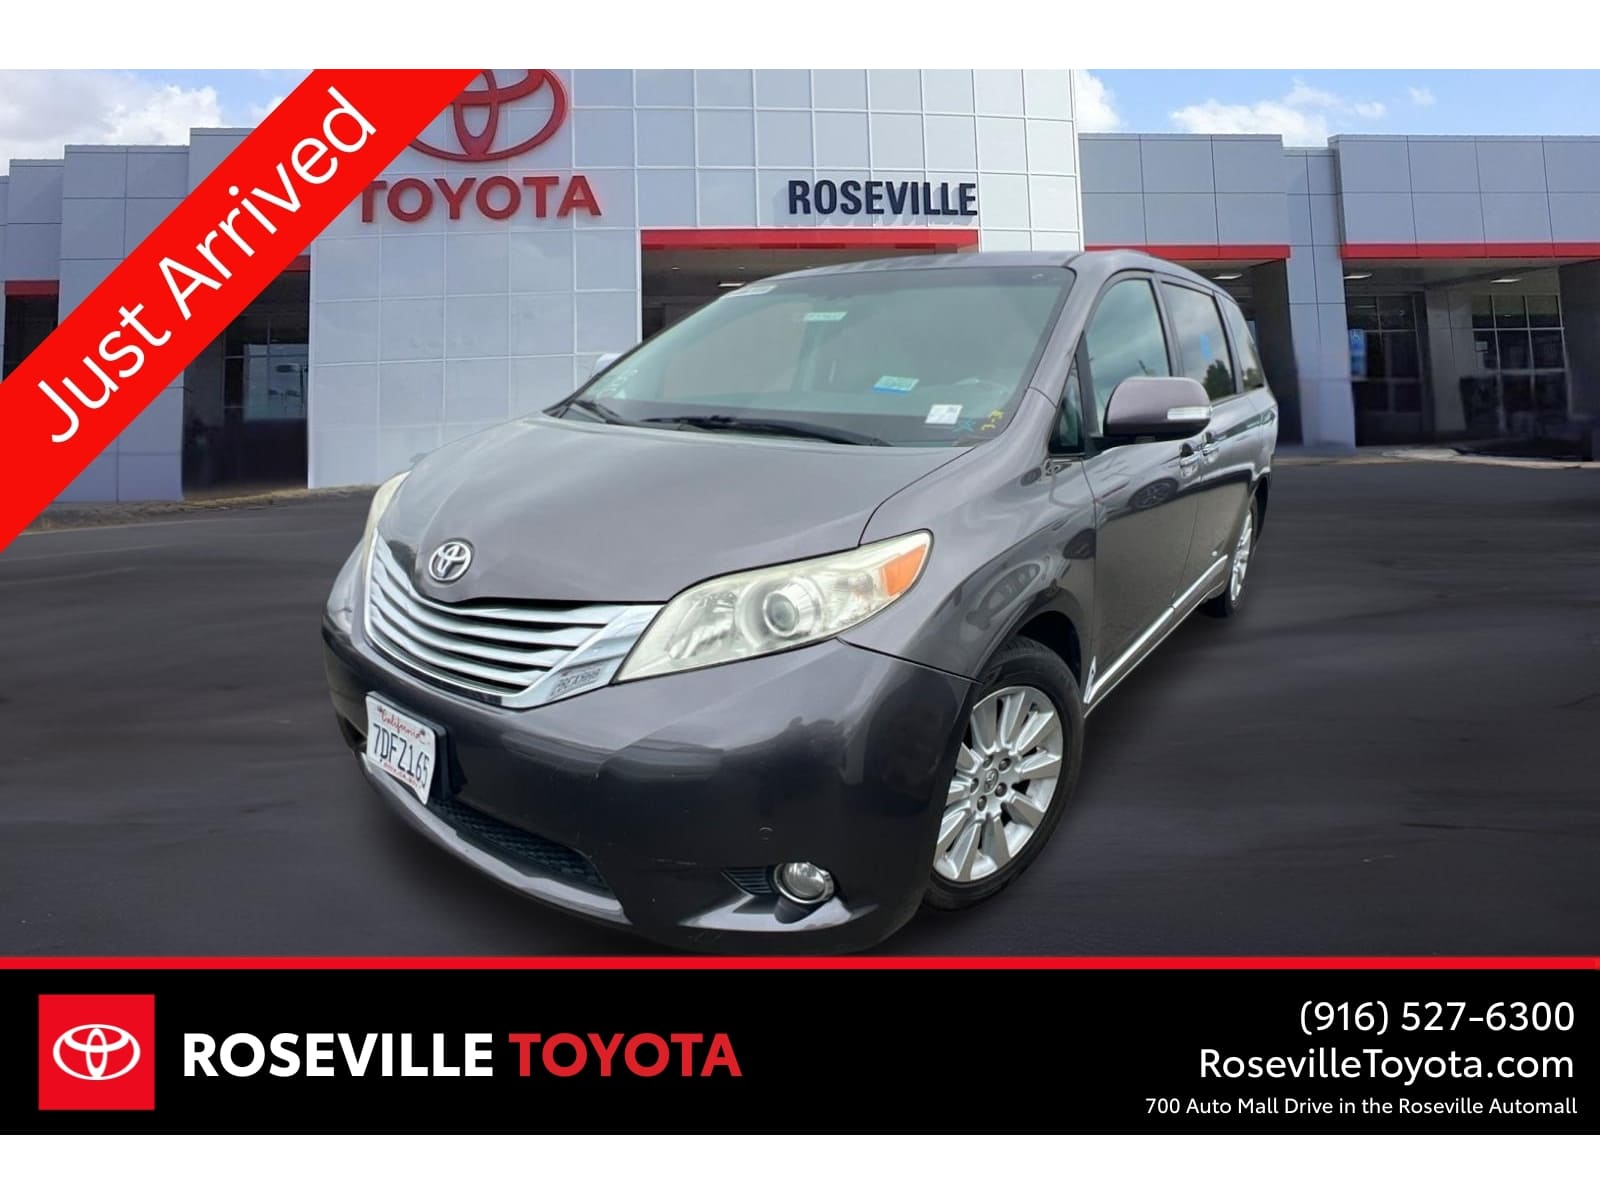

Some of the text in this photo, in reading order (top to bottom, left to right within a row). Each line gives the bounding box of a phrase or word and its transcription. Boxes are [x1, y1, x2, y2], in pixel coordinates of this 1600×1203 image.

[361, 175, 602, 223] TOYOTA
[788, 179, 978, 216] ROSEVILLE
[373, 722, 430, 788] 7DFZ165
